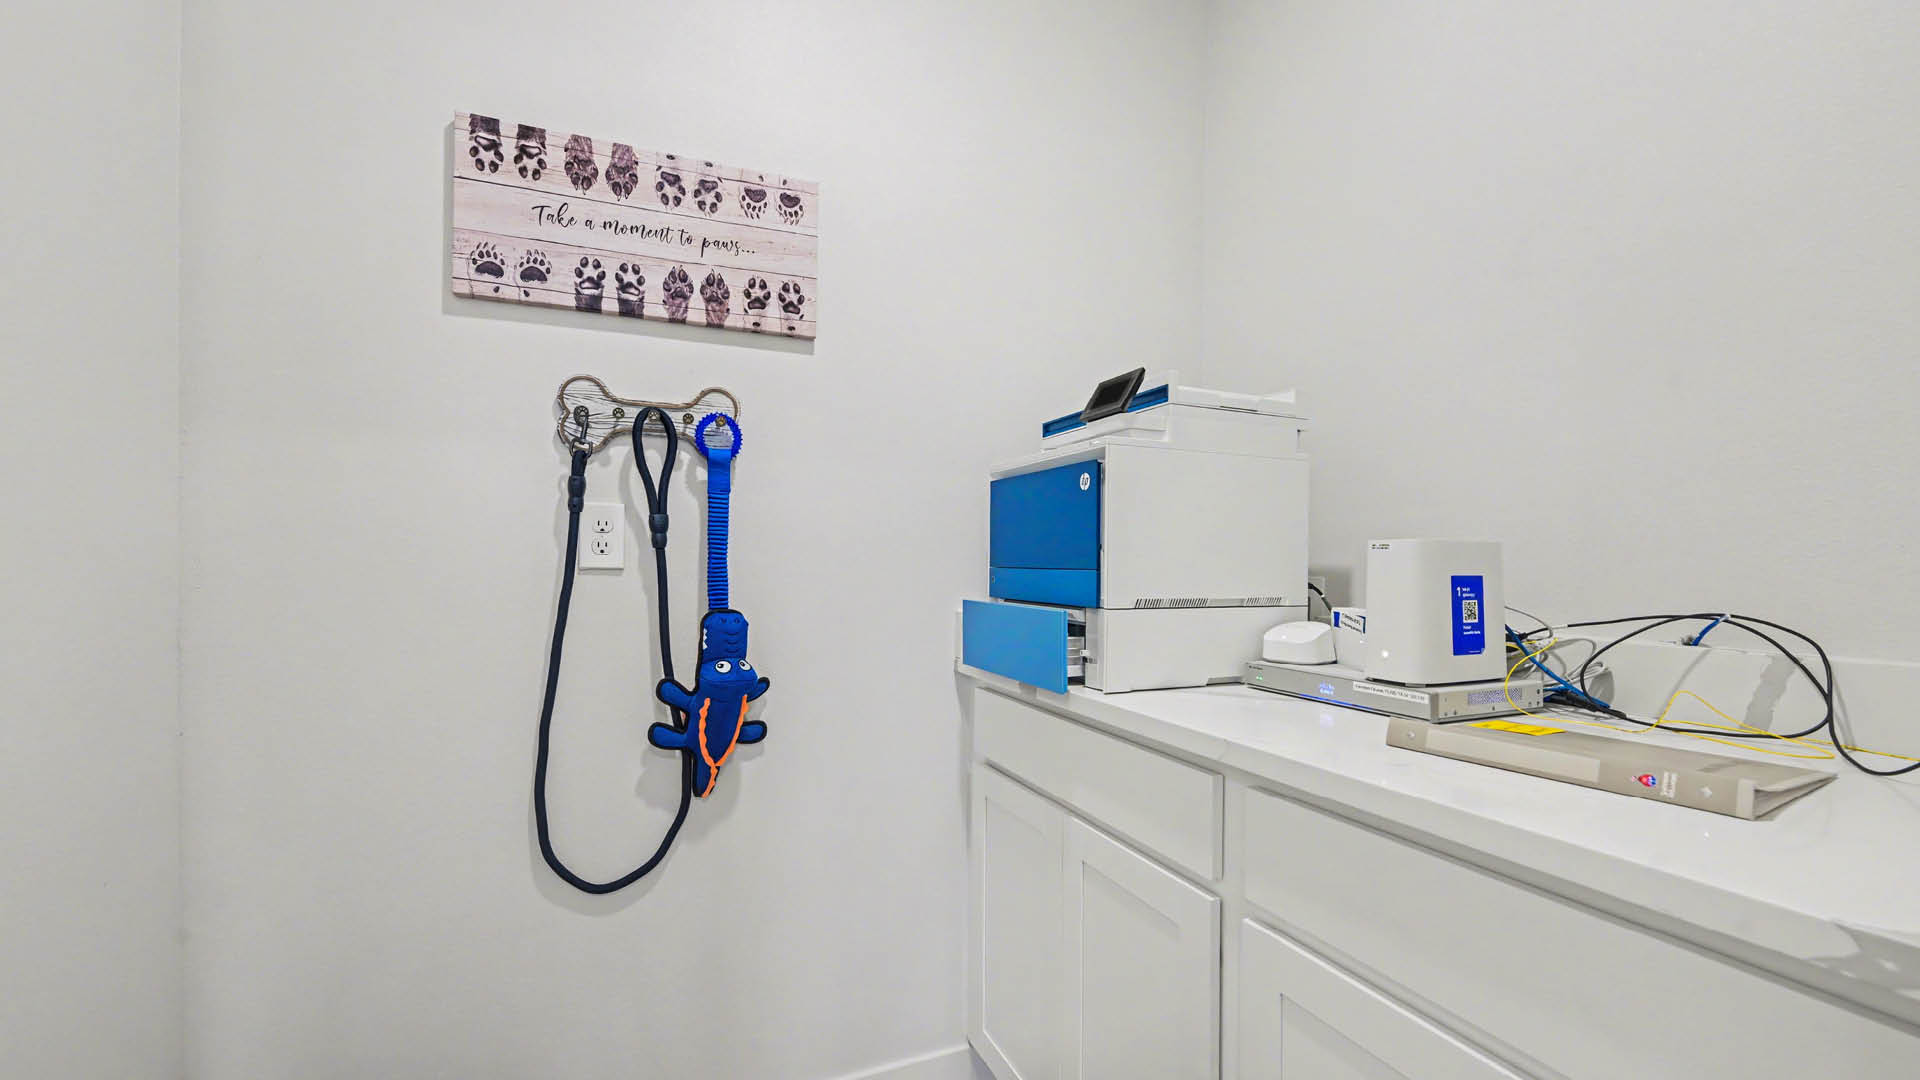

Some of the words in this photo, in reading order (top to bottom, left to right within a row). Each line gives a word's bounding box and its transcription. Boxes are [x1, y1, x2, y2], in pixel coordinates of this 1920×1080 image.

[532, 202, 577, 228] Take
[585, 218, 596, 231] a
[600, 218, 675, 244] moment
[675, 228, 694, 246] to
[701, 236, 756, 258] paws...
